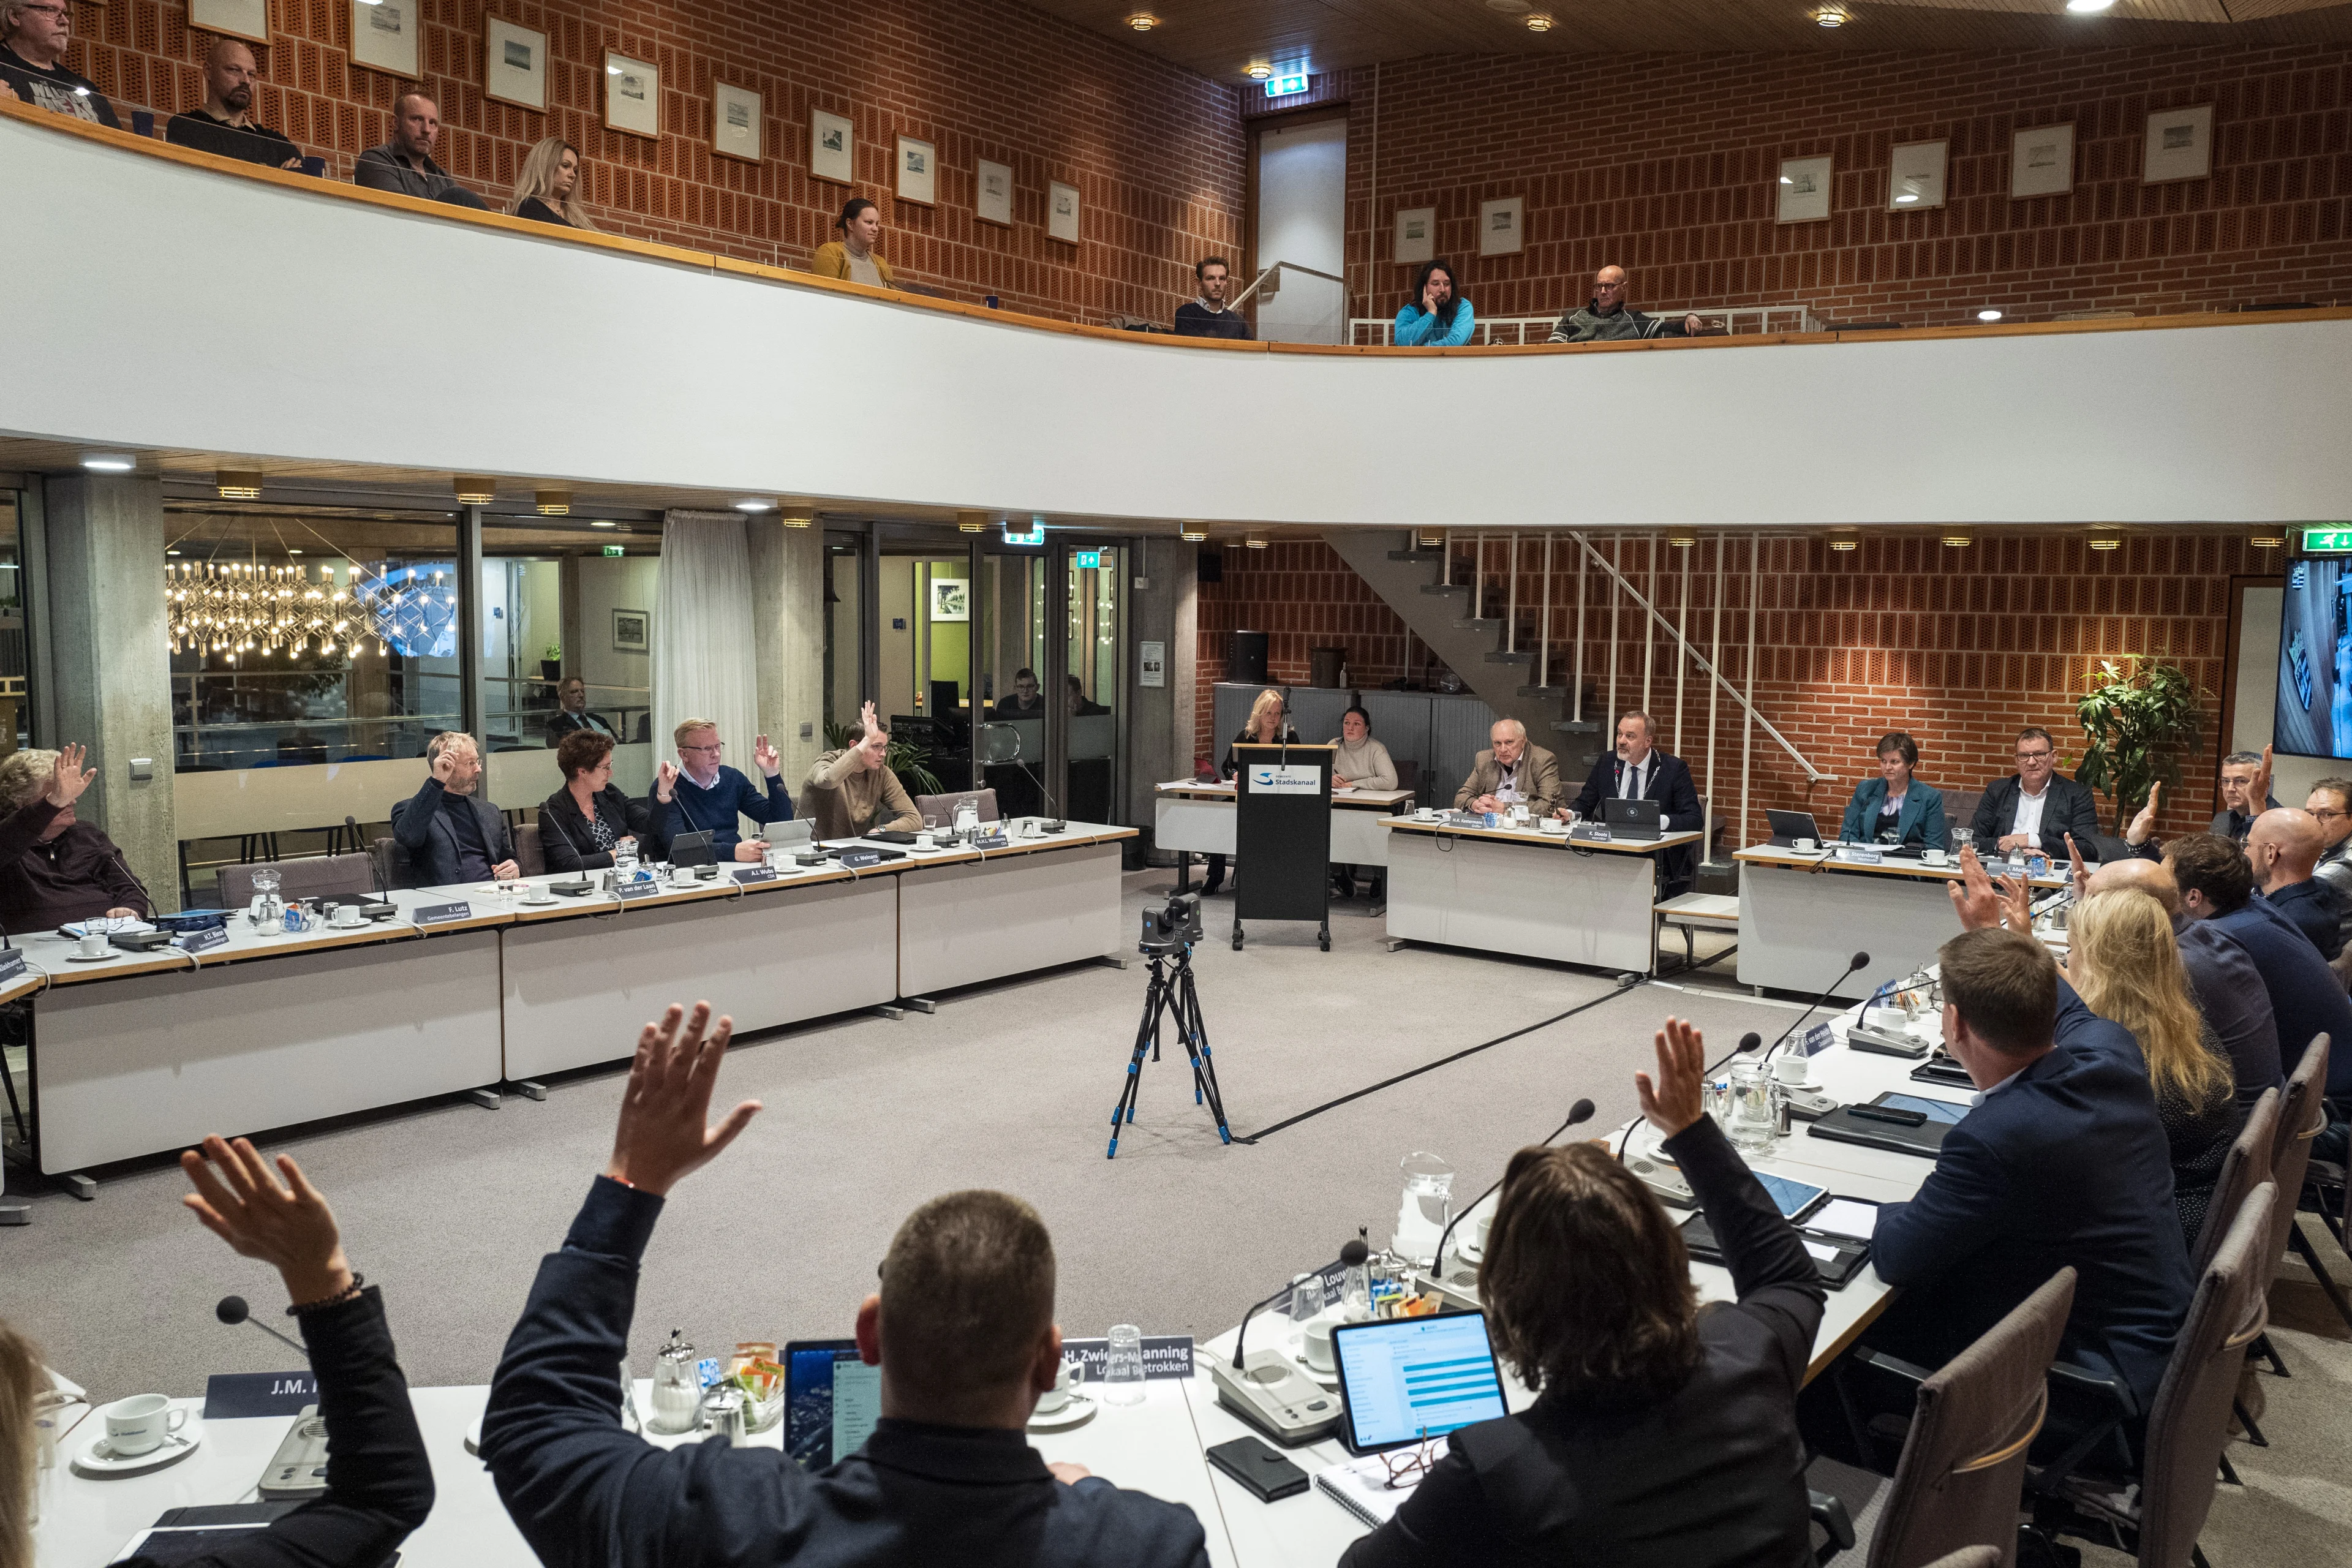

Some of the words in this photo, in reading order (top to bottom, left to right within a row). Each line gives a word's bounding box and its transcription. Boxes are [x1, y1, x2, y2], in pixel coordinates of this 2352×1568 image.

[427, 911, 469, 921] Gemeentebelangen
[1065, 1350, 1079, 1362] H.
[271, 1379, 307, 1395] J.M.
